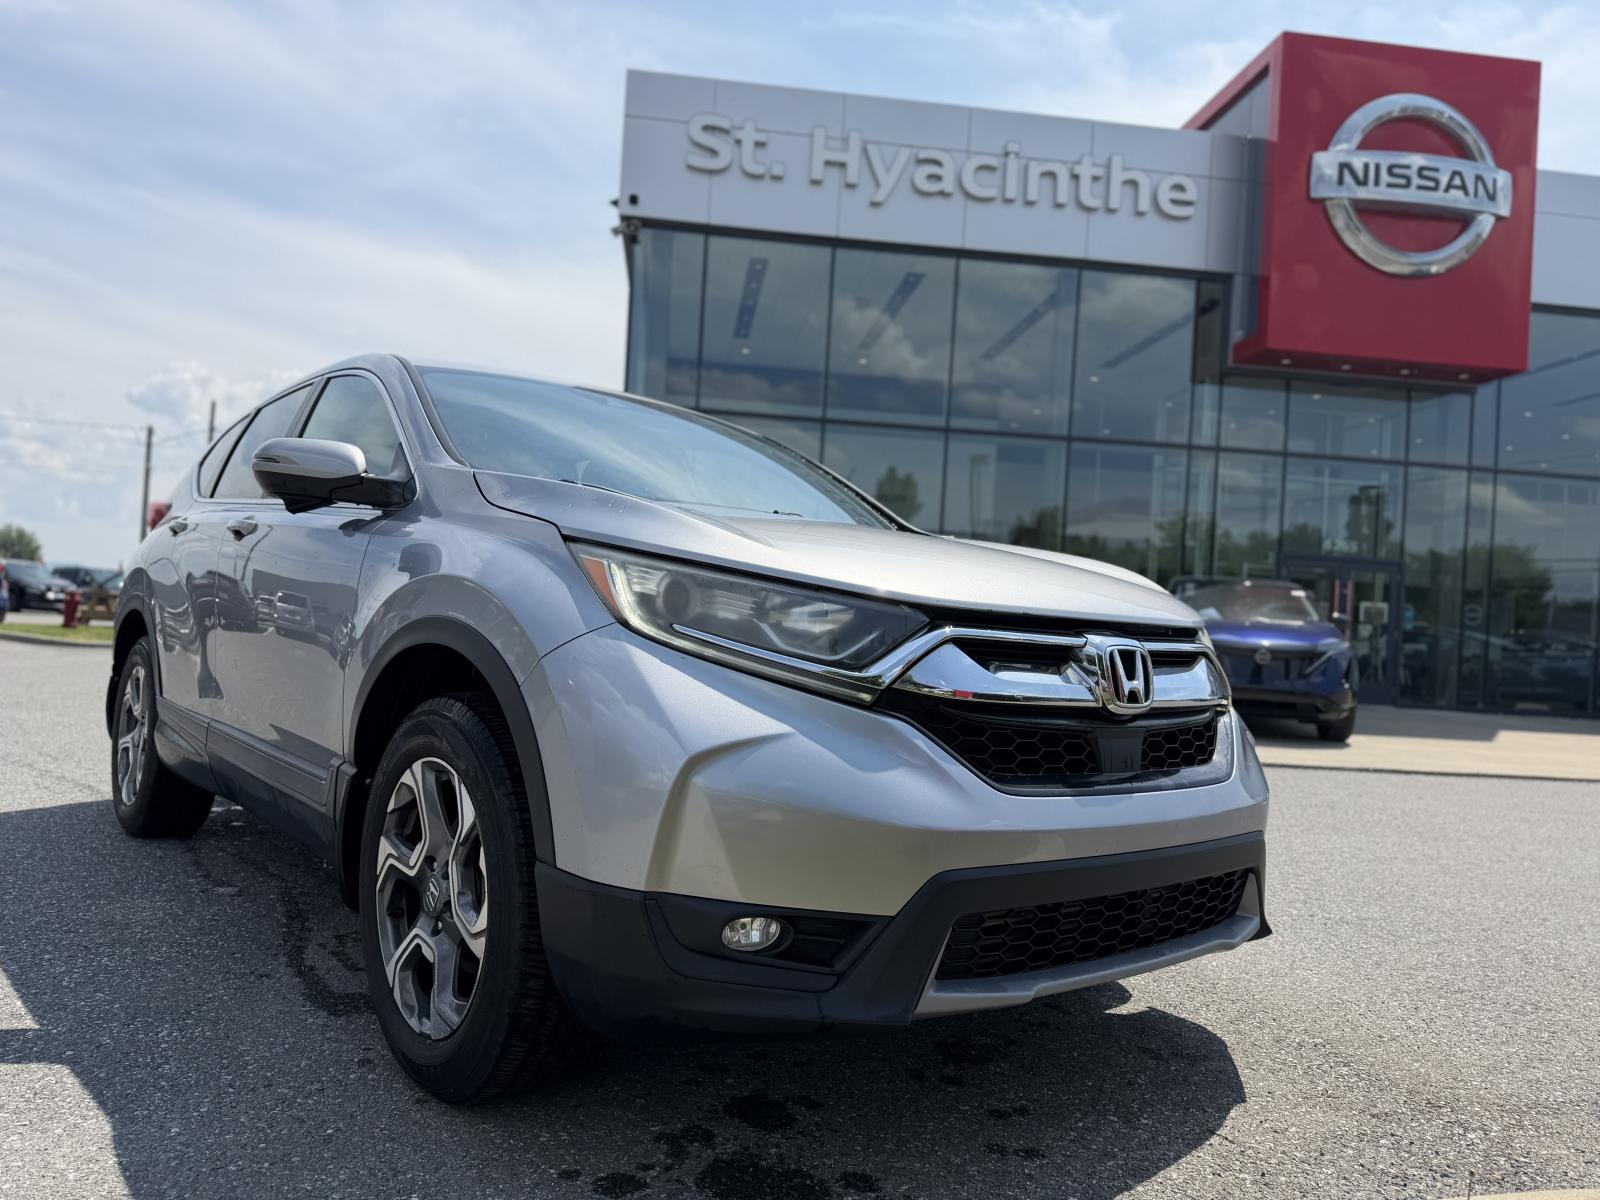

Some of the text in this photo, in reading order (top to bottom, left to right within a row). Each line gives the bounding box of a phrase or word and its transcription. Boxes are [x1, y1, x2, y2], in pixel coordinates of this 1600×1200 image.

[686, 114, 1198, 220] St. Hyacinthe
[1338, 161, 1498, 203] NISSAN
